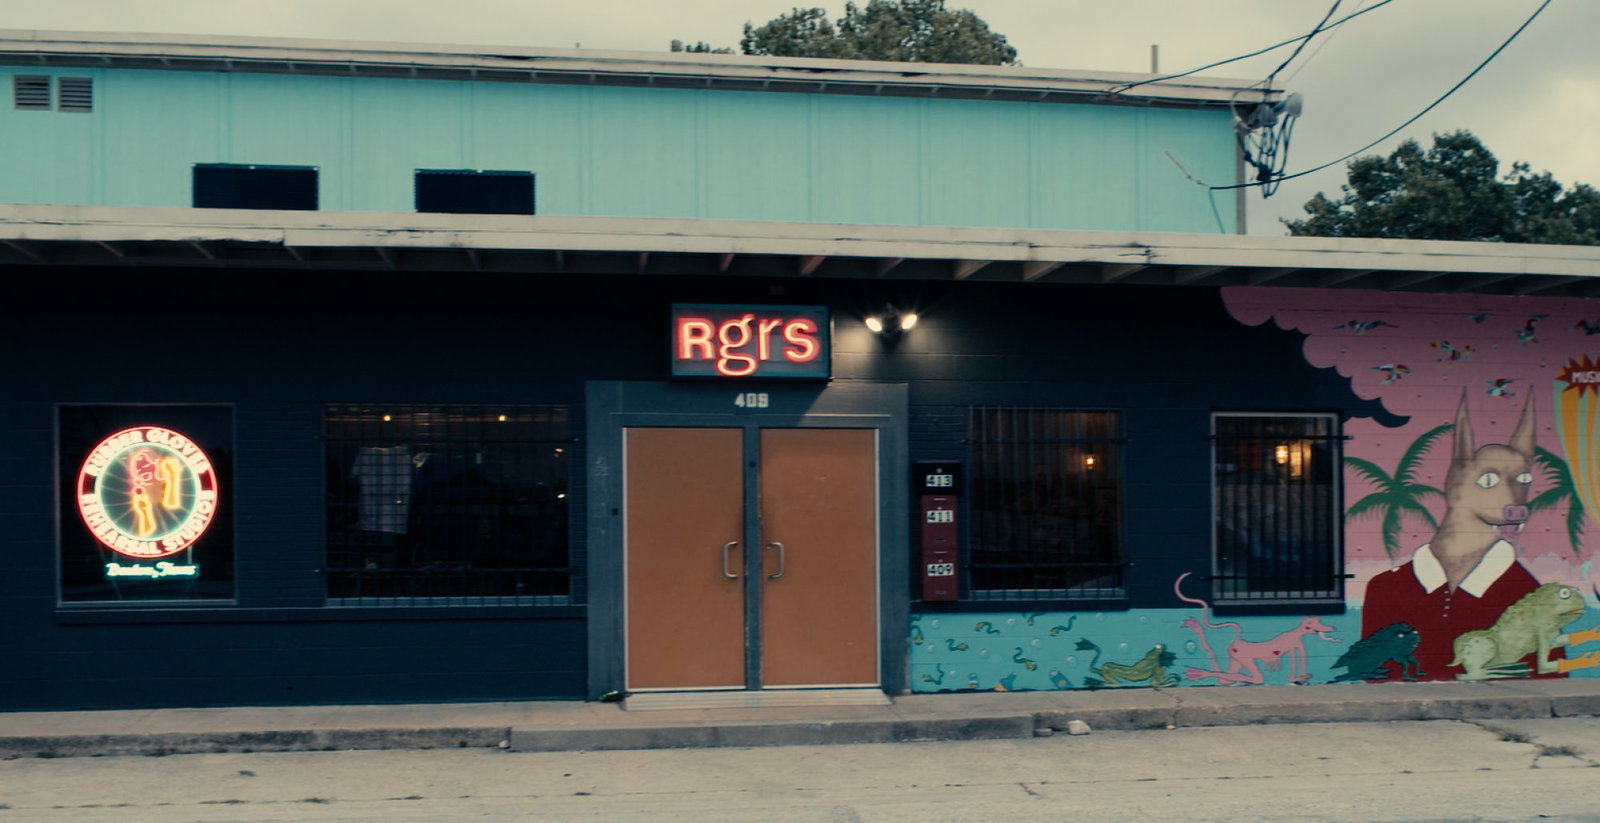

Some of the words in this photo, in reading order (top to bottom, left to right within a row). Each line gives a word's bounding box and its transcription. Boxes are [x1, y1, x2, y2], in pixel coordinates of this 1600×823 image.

[676, 314, 820, 376] Rgrs
[734, 393, 769, 408] 409
[84, 430, 144, 476] RUBBER
[146, 429, 211, 474] GLOVES
[926, 475, 953, 487] 413
[163, 490, 216, 551] STUDIOS
[927, 510, 953, 523] 411
[927, 563, 954, 576] 409
